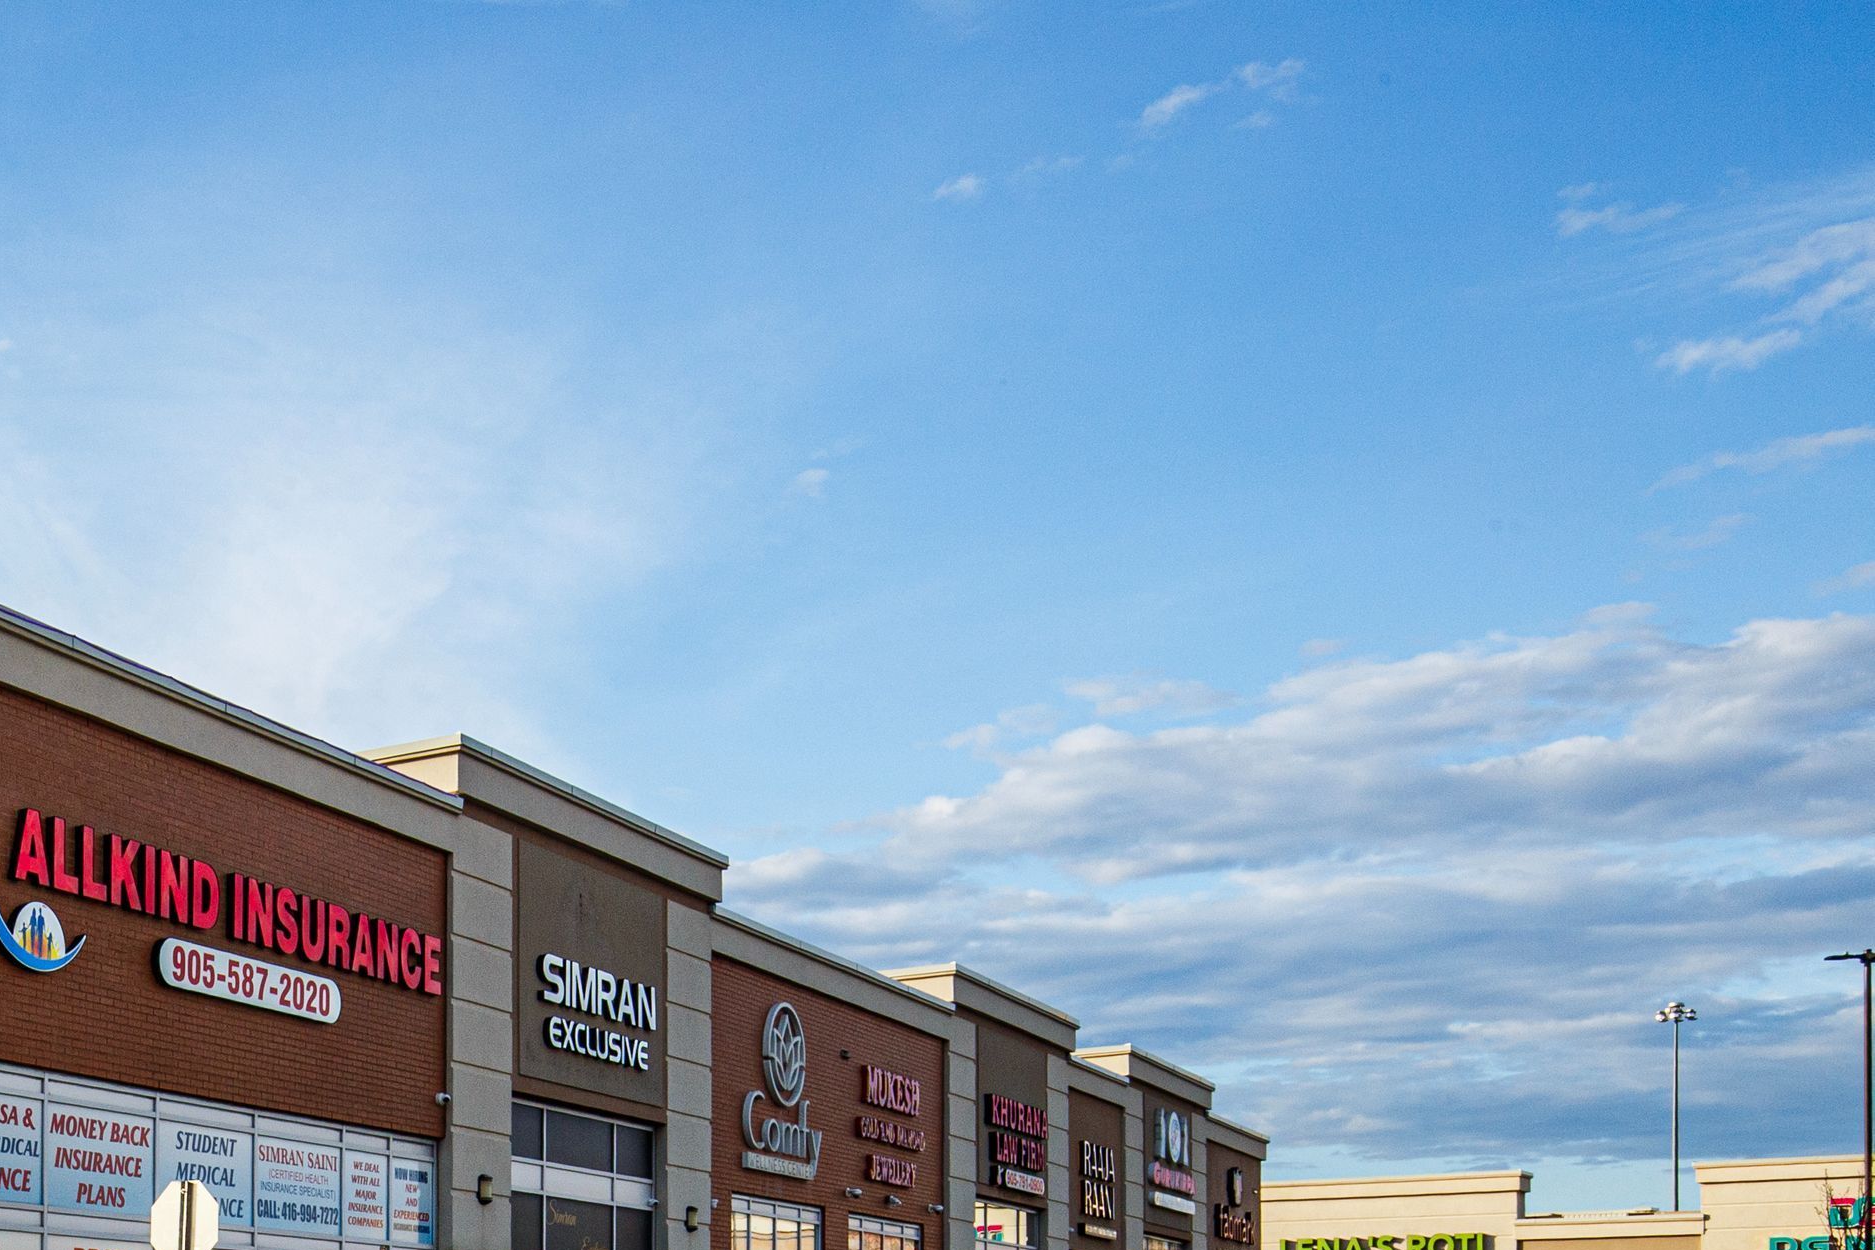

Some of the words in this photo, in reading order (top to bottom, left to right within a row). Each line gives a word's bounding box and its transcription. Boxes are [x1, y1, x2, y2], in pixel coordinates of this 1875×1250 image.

[15, 808, 220, 930] ALLKIND
[232, 873, 443, 995] INSURANCE
[171, 945, 331, 1017] 905-587-2020
[542, 953, 657, 1031] SIMRAN
[549, 1016, 649, 1071] EXCLUSIVE
[868, 1064, 921, 1117] MUKESH
[22, 1108, 36, 1130] &
[50, 1113, 108, 1141] MONEY
[109, 1122, 150, 1148] BACK
[992, 1094, 1048, 1140] KHURANA
[175, 1130, 237, 1158] STUDENT
[743, 1090, 823, 1178] Comfy
[54, 1147, 143, 1178] INSURANCE
[258, 1144, 304, 1168] SIMRAN
[307, 1151, 338, 1172] SAINI
[353, 1161, 363, 1171] WE
[365, 1162, 380, 1173] DEAL
[997, 1131, 1018, 1165] LAW
[1021, 1138, 1046, 1173] FIRM
[76, 1182, 126, 1208] PLANS
[351, 1174, 368, 1185] WITH
[368, 1177, 381, 1187] ALL
[405, 1184, 418, 1193] NEW
[257, 1200, 280, 1219] CALL:
[281, 1201, 338, 1226] 416-994-7272
[405, 1197, 418, 1207] AND
